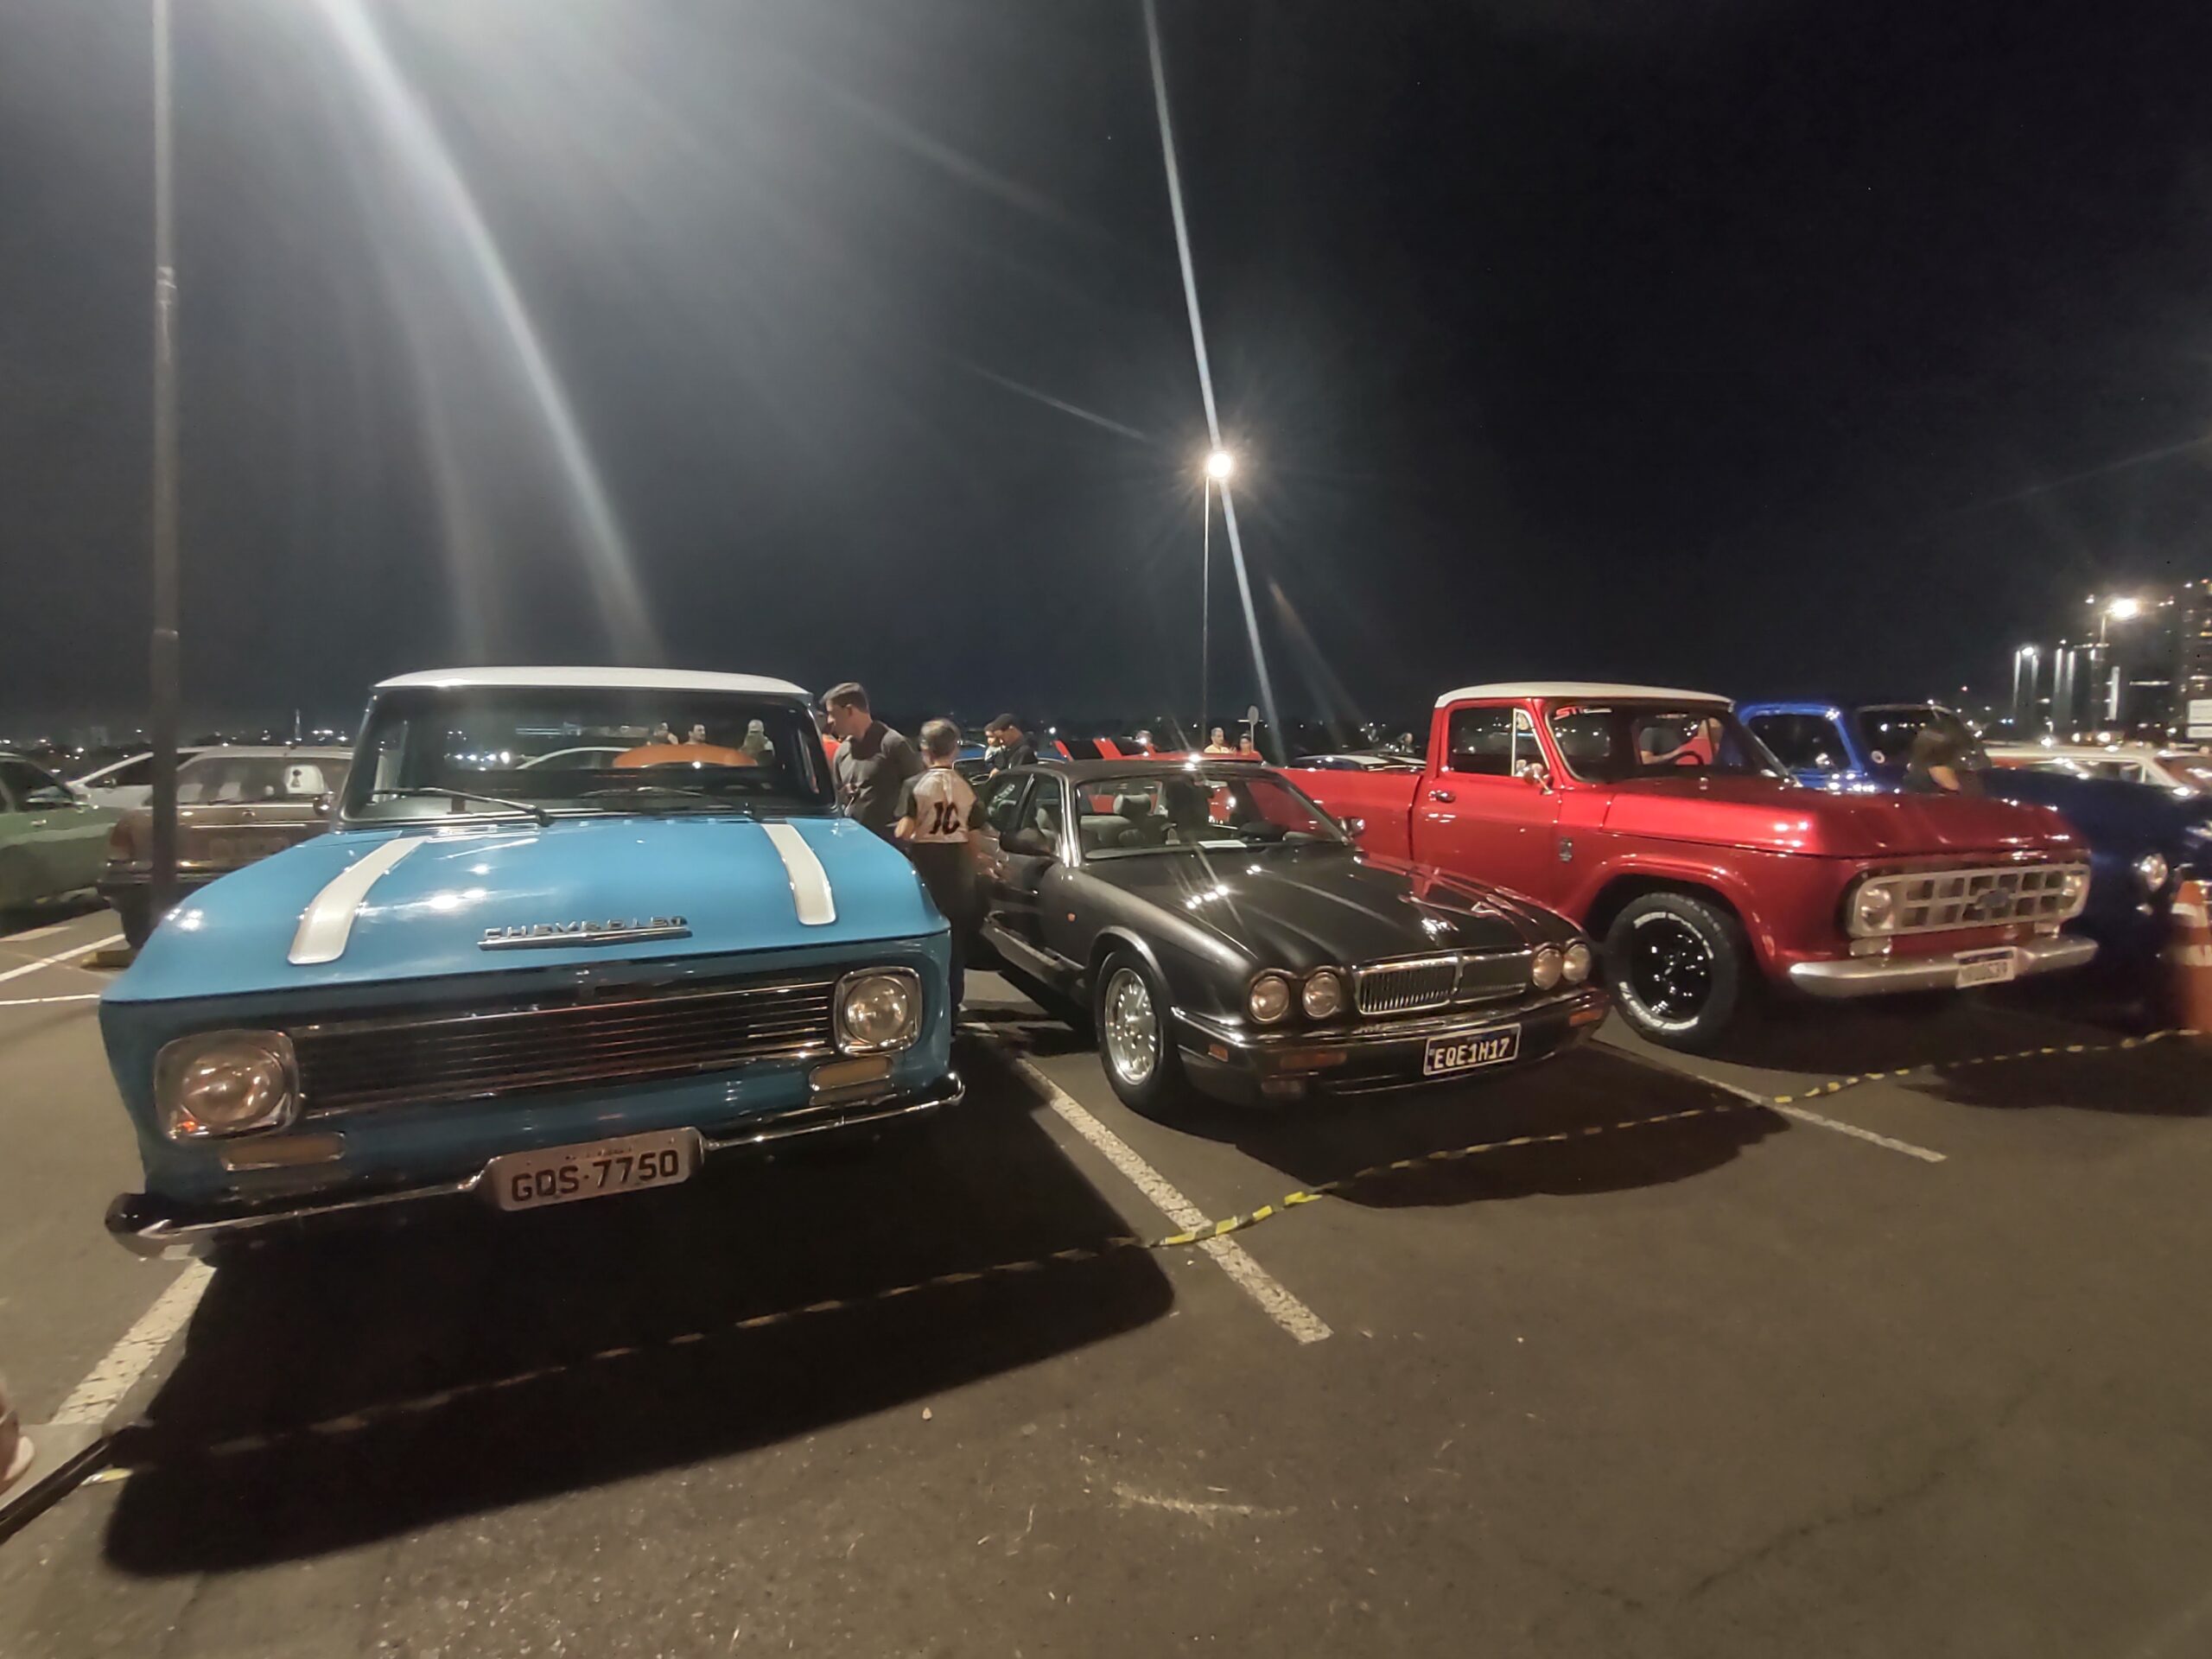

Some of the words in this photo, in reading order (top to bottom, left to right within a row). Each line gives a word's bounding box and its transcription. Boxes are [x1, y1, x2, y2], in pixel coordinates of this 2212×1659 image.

[929, 801, 961, 836] 10
[484, 916, 688, 940] CHEVROLET
[1433, 1037, 1510, 1070] EQE1H17
